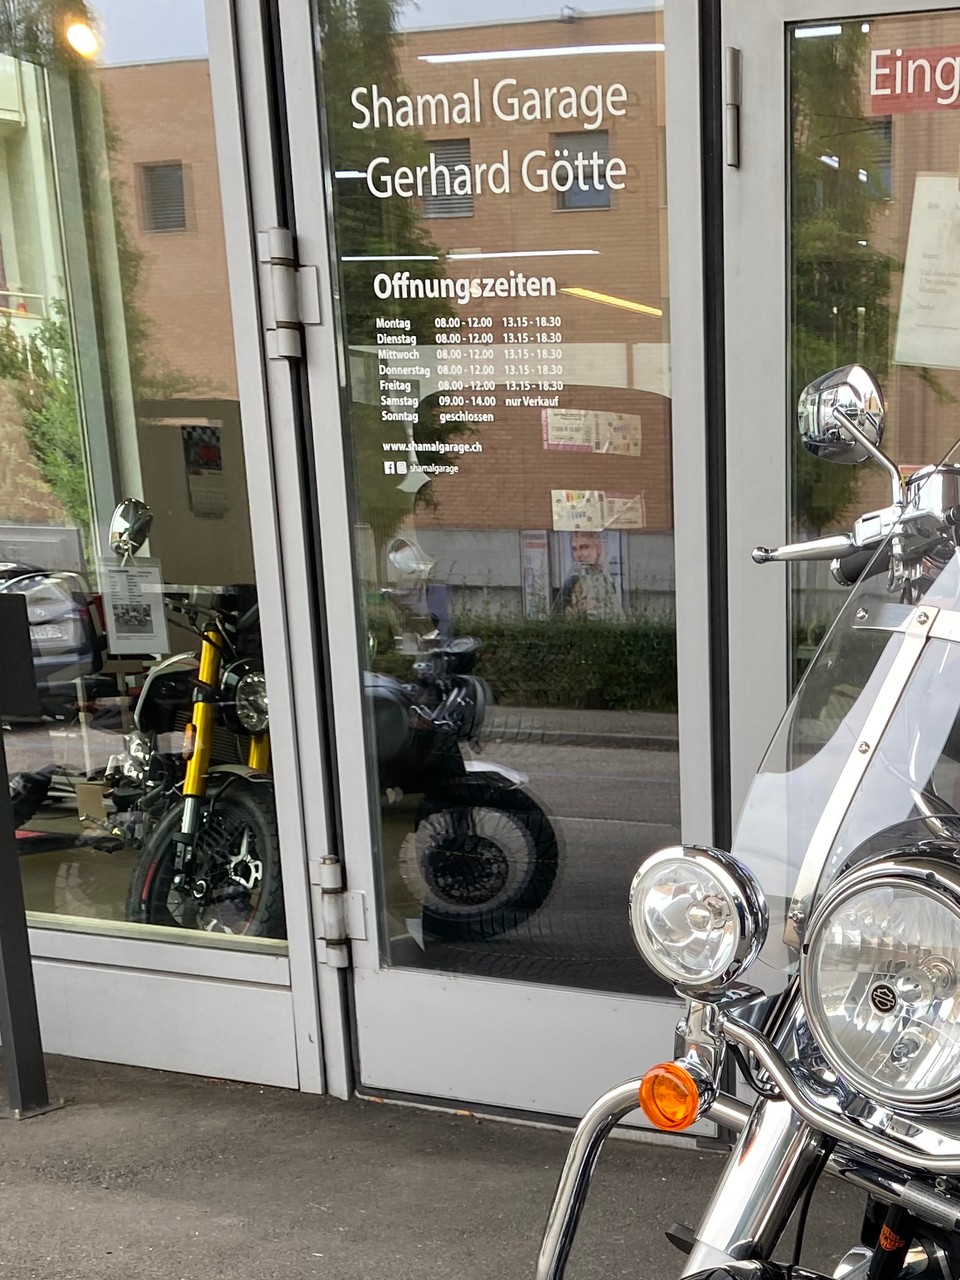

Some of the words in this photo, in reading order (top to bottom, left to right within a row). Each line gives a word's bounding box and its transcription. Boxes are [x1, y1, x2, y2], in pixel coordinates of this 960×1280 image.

[350, 78, 481, 129] Shamal
[492, 78, 628, 130] Garage
[366, 150, 510, 198] Gerhard
[521, 149, 627, 192] Götte
[376, 318, 411, 331] Montag
[434, 317, 460, 328] 08.00
[467, 317, 493, 327] 12.00
[502, 316, 528, 327] 13.15
[535, 316, 561, 327] 18.30
[377, 333, 417, 346] Dienstag
[435, 333, 461, 344] 08.00
[468, 333, 493, 343] 12.00
[503, 333, 529, 343] 13.15
[536, 332, 562, 343] 18.30
[378, 348, 420, 359] Mittwoch
[436, 349, 462, 359] 08.00
[469, 349, 494, 359] 12.00
[504, 349, 529, 359] 13.15
[537, 349, 563, 359] 18.30
[378, 364, 431, 378] Donnerstag
[437, 365, 463, 375] 08.00
[469, 365, 495, 375] 12.00
[504, 365, 530, 375] 13.15
[537, 365, 563, 375] 18.30
[379, 380, 411, 393] Freitag
[438, 380, 463, 391] 08.00
[470, 381, 496, 391] 12.00
[505, 381, 531, 391] 13.15
[538, 381, 564, 391] 18.30
[380, 395, 419, 408] Samstag
[438, 396, 464, 406] 09.00
[471, 396, 496, 406] 14.00
[505, 398, 521, 406] nur
[522, 396, 559, 407] Verkauf
[381, 411, 419, 423] Sonntag
[440, 411, 494, 424] geschlossen
[382, 440, 483, 455] www.shamalgarage.ch
[409, 463, 459, 475] shamalgarage
